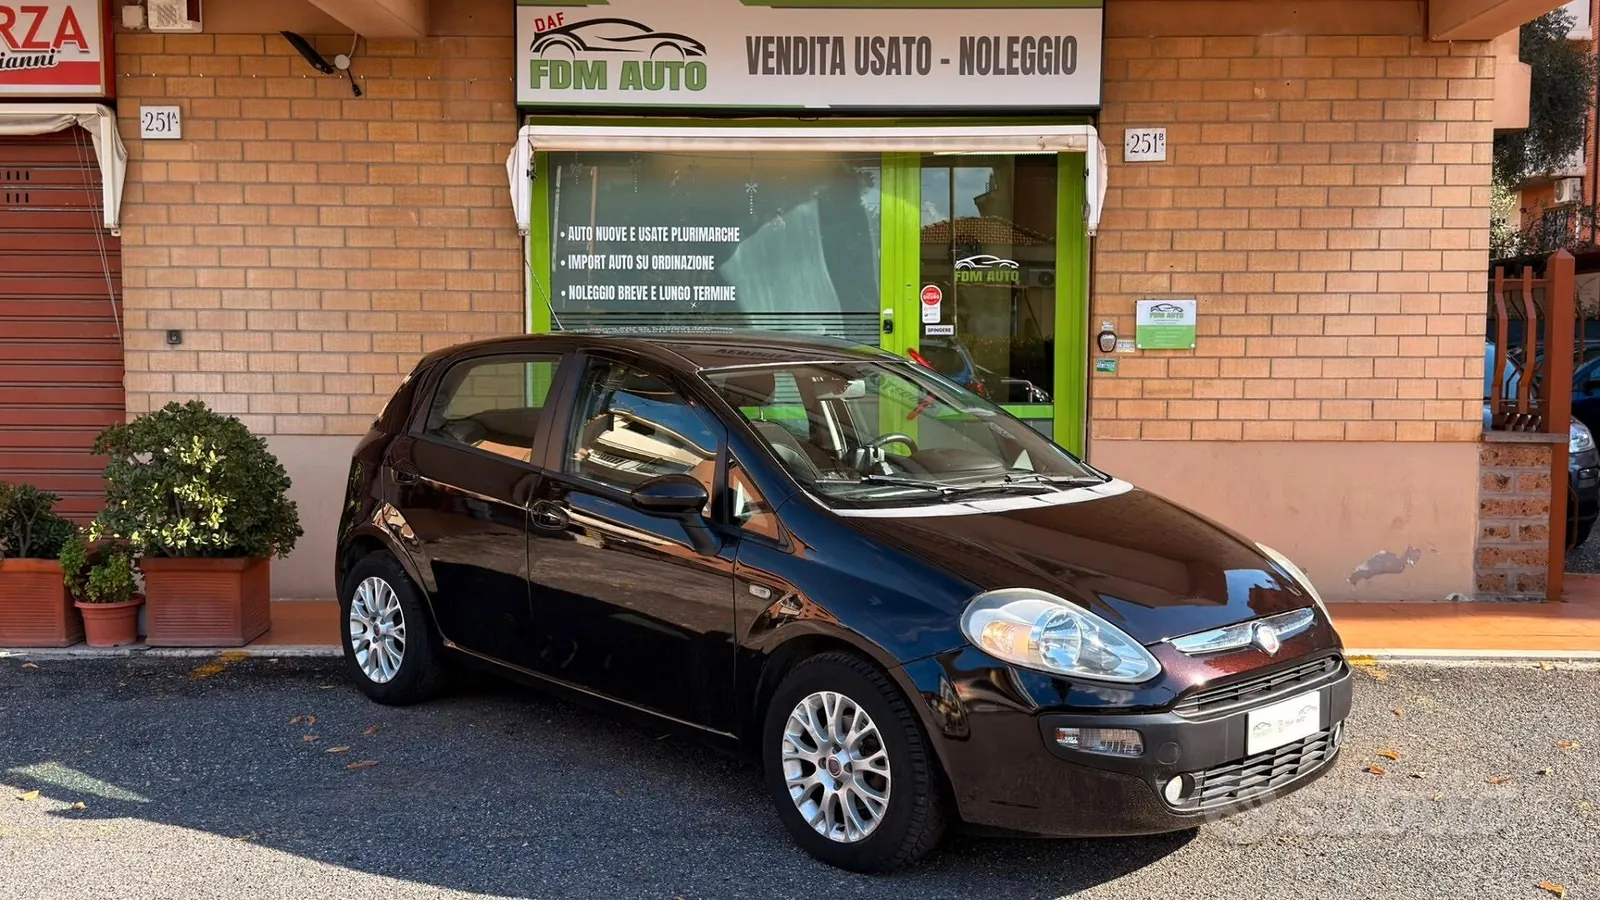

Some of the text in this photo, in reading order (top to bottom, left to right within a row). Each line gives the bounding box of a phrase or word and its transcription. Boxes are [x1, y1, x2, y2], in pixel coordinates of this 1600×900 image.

[535, 12, 564, 32] DAF
[745, 36, 846, 75] VENDITA
[854, 36, 932, 76] USATO
[959, 36, 1078, 76] NOLEGGIO
[530, 59, 707, 91] FDM AUTO
[568, 226, 740, 242] AUTO NUOVE E USATE PLURIMARCHE
[568, 254, 715, 271] IMPORT AUTO SU ORDINAZIONE
[955, 270, 1019, 282] FDM AUTO
[568, 285, 736, 301] NOLEGGIO BREVE E LUNGO TERMINE
